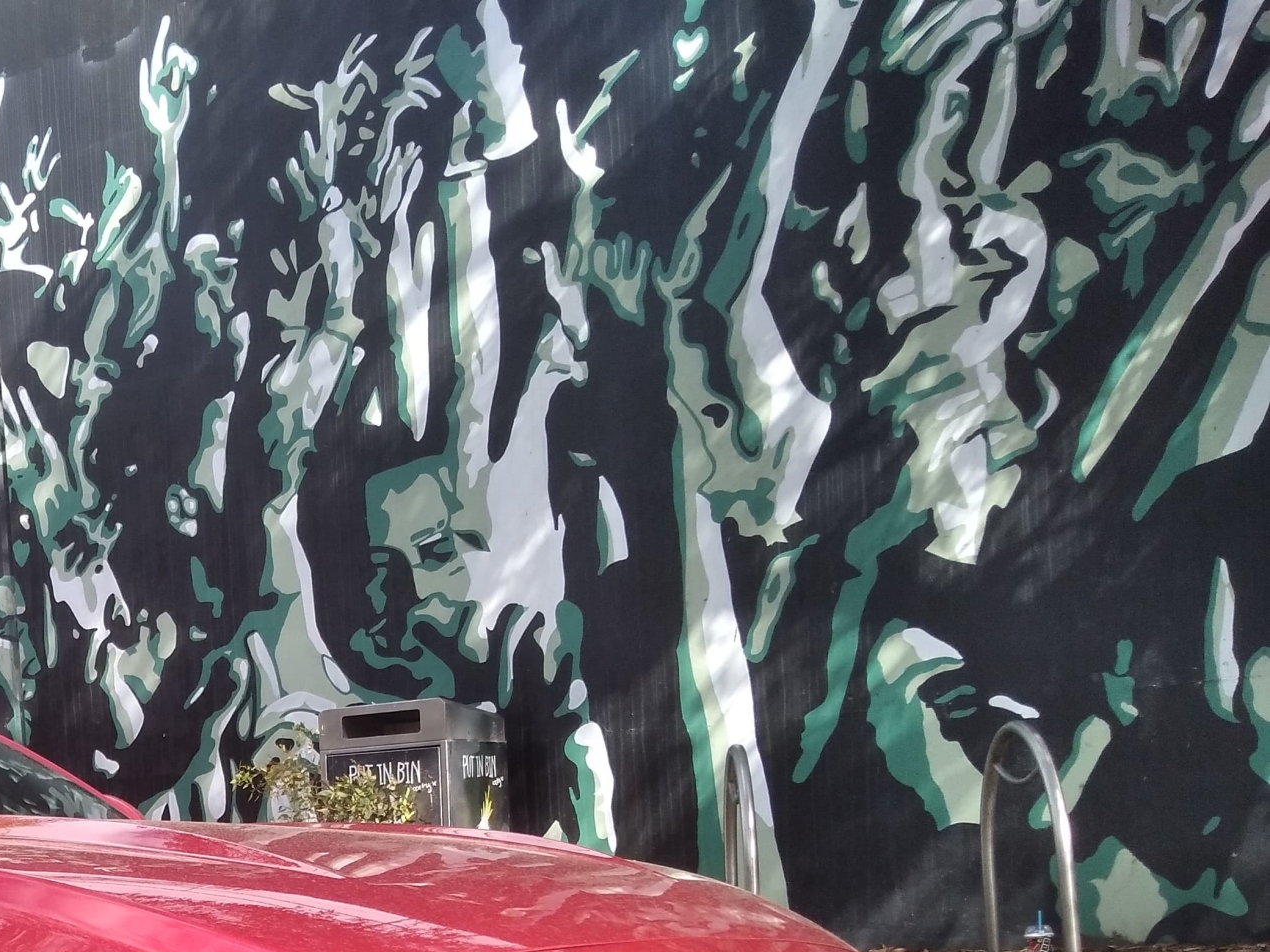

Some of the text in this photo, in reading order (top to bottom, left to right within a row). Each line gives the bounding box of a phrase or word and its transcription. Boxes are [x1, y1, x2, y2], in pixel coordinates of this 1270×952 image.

[376, 761, 393, 785] IN
[397, 759, 422, 784] BIN
[462, 754, 497, 779] PUT IN BIN
